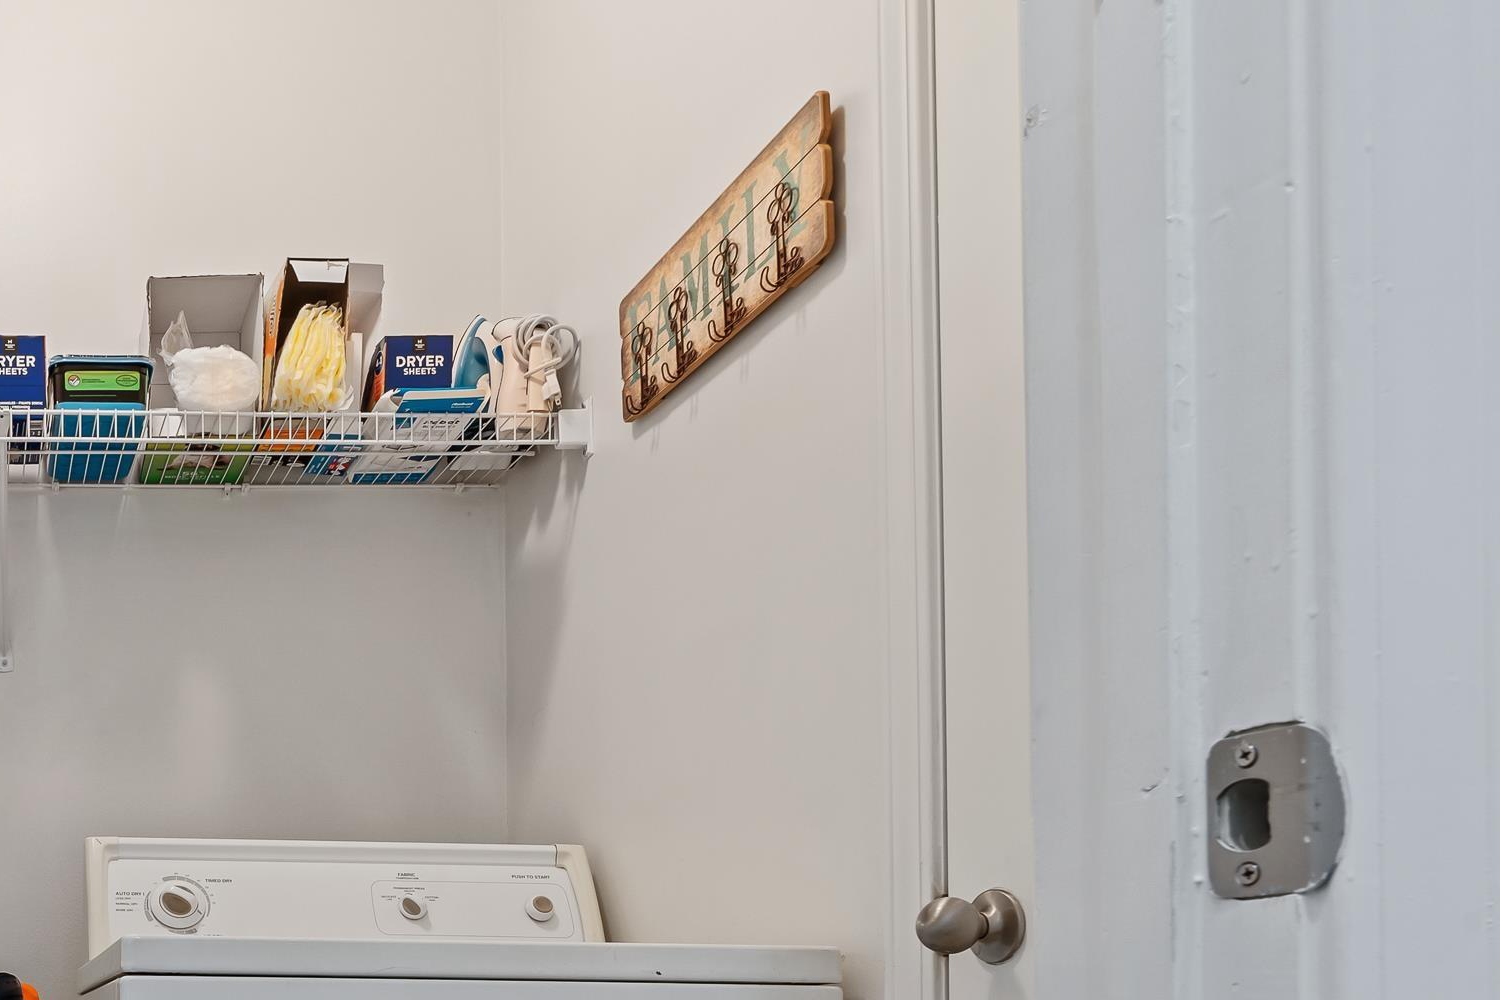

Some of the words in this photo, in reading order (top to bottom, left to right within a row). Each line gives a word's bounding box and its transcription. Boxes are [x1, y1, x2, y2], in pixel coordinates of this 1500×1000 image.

[626, 122, 816, 388] FAMILY
[395, 354, 445, 368] DRYER
[403, 367, 437, 376] SHEETS
